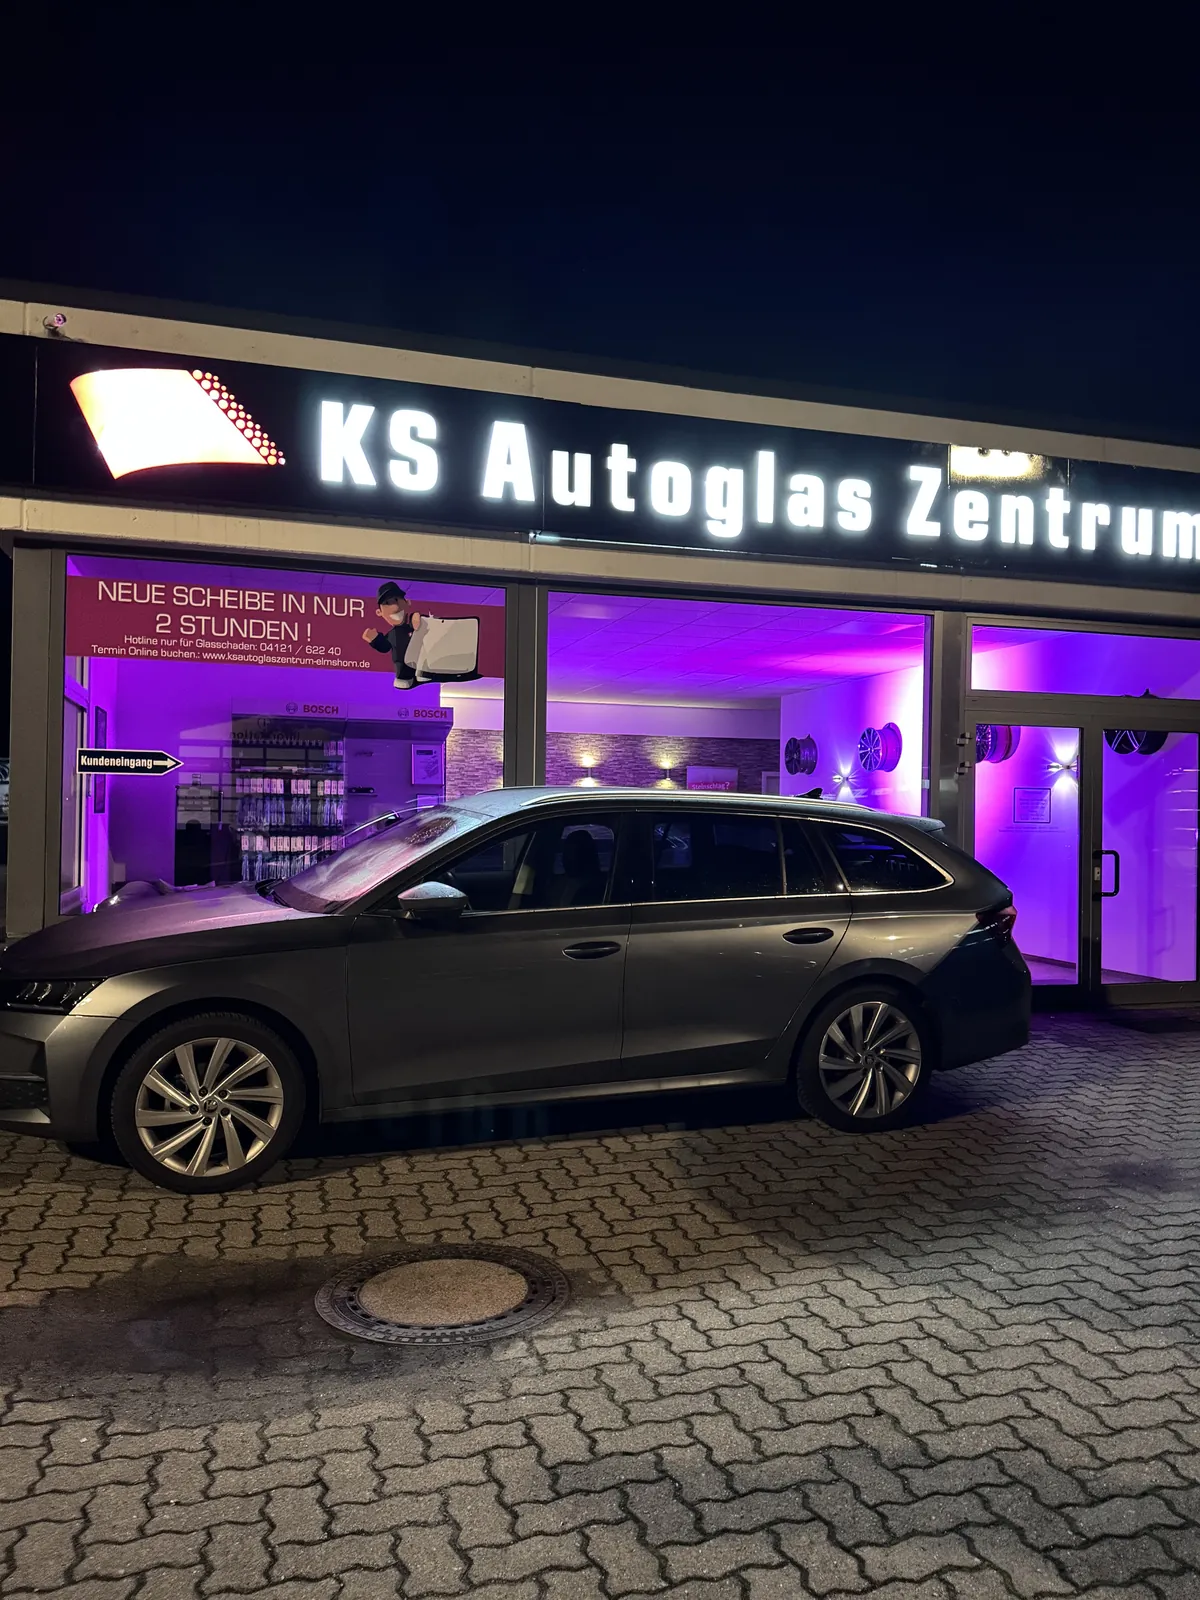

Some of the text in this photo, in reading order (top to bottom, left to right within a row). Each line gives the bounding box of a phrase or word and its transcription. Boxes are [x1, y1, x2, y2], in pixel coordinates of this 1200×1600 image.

[320, 400, 1200, 560] KS Autoglas Zentrum
[98, 580, 365, 618] NEUE SCHEIBE IN NUR
[156, 613, 311, 642] 2 STUNDEN !
[91, 644, 126, 655] Termin
[128, 646, 158, 656] Online
[161, 647, 200, 659] buchen.:
[124, 635, 341, 656] Hotline nur für Glasschaden: 04121 / 622 40
[303, 705, 339, 714] BOSCH
[413, 709, 448, 718] BOSCH
[80, 755, 153, 769] Kundeneingang
